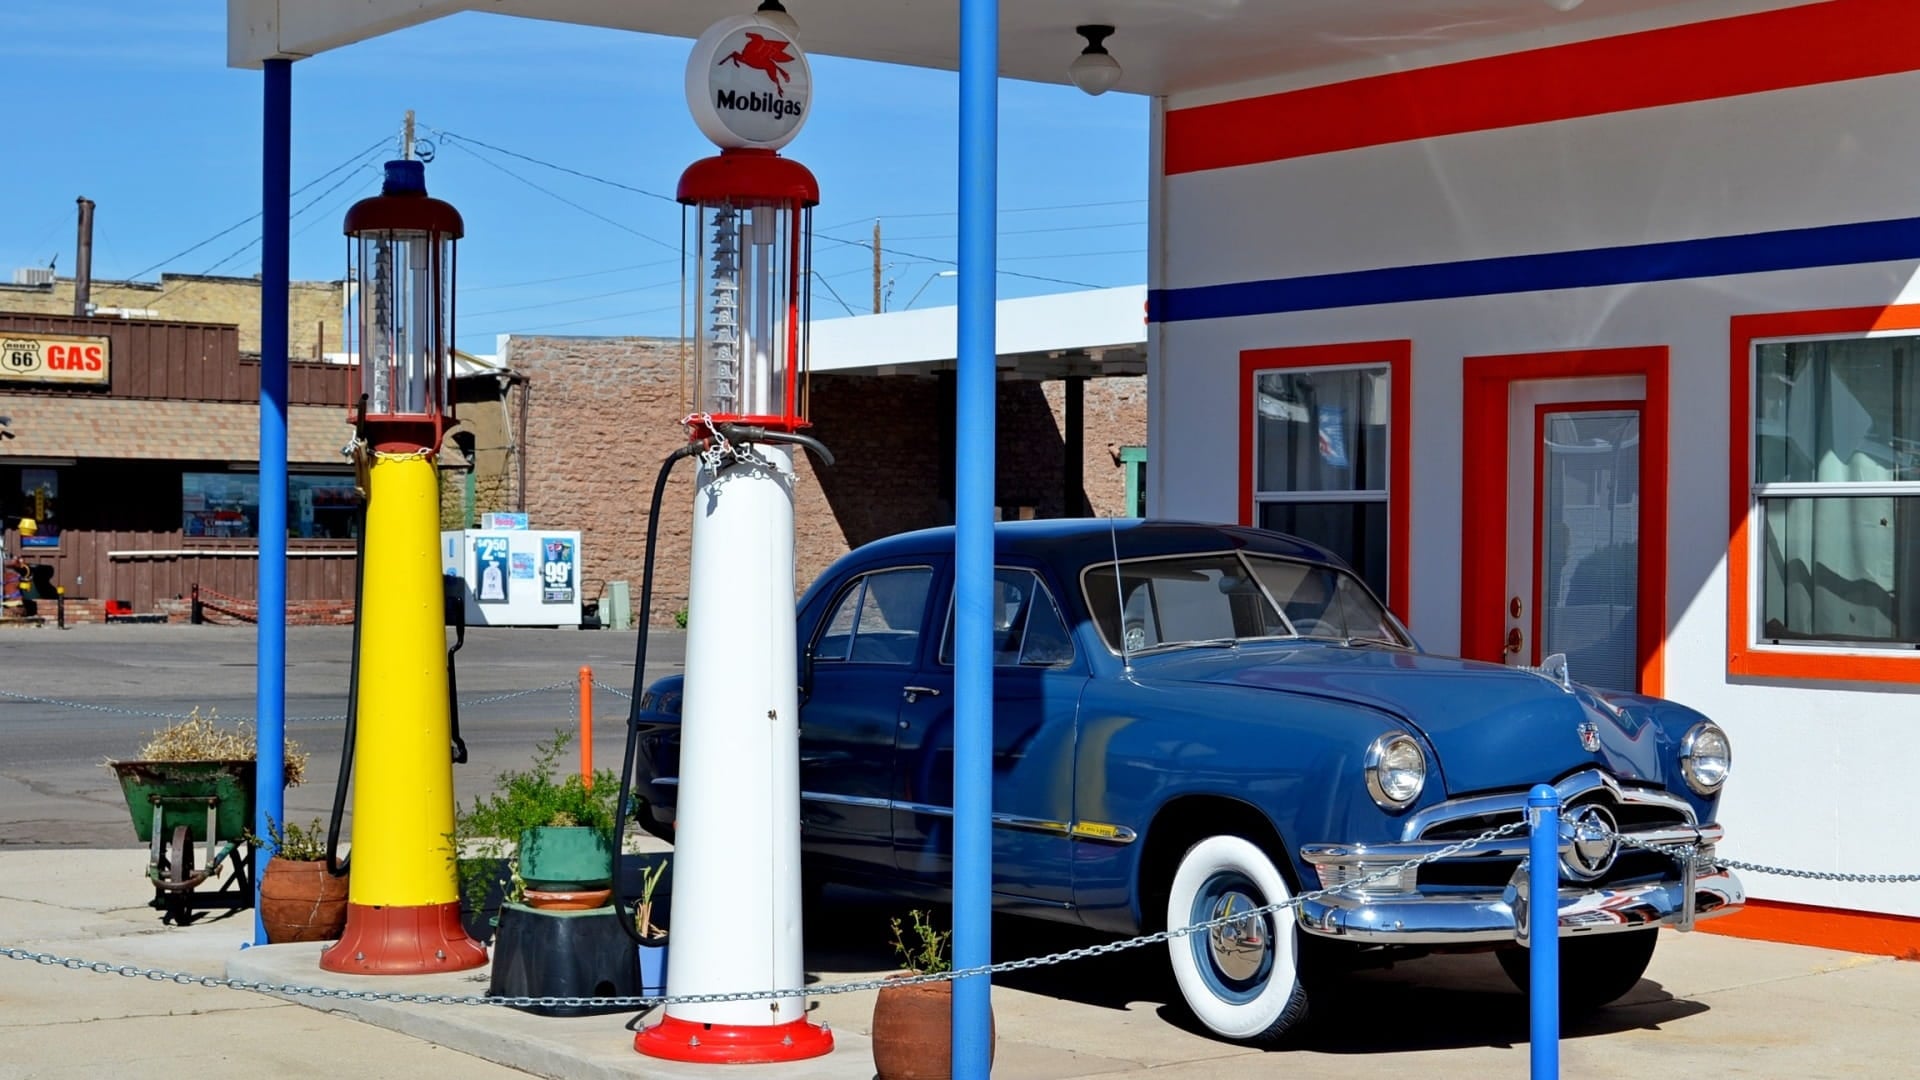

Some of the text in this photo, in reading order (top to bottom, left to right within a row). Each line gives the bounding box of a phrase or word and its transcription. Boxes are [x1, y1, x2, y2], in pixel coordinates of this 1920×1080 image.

[717, 89, 801, 120] Mobilgas
[11, 351, 33, 367] 66
[47, 345, 102, 371] GAS
